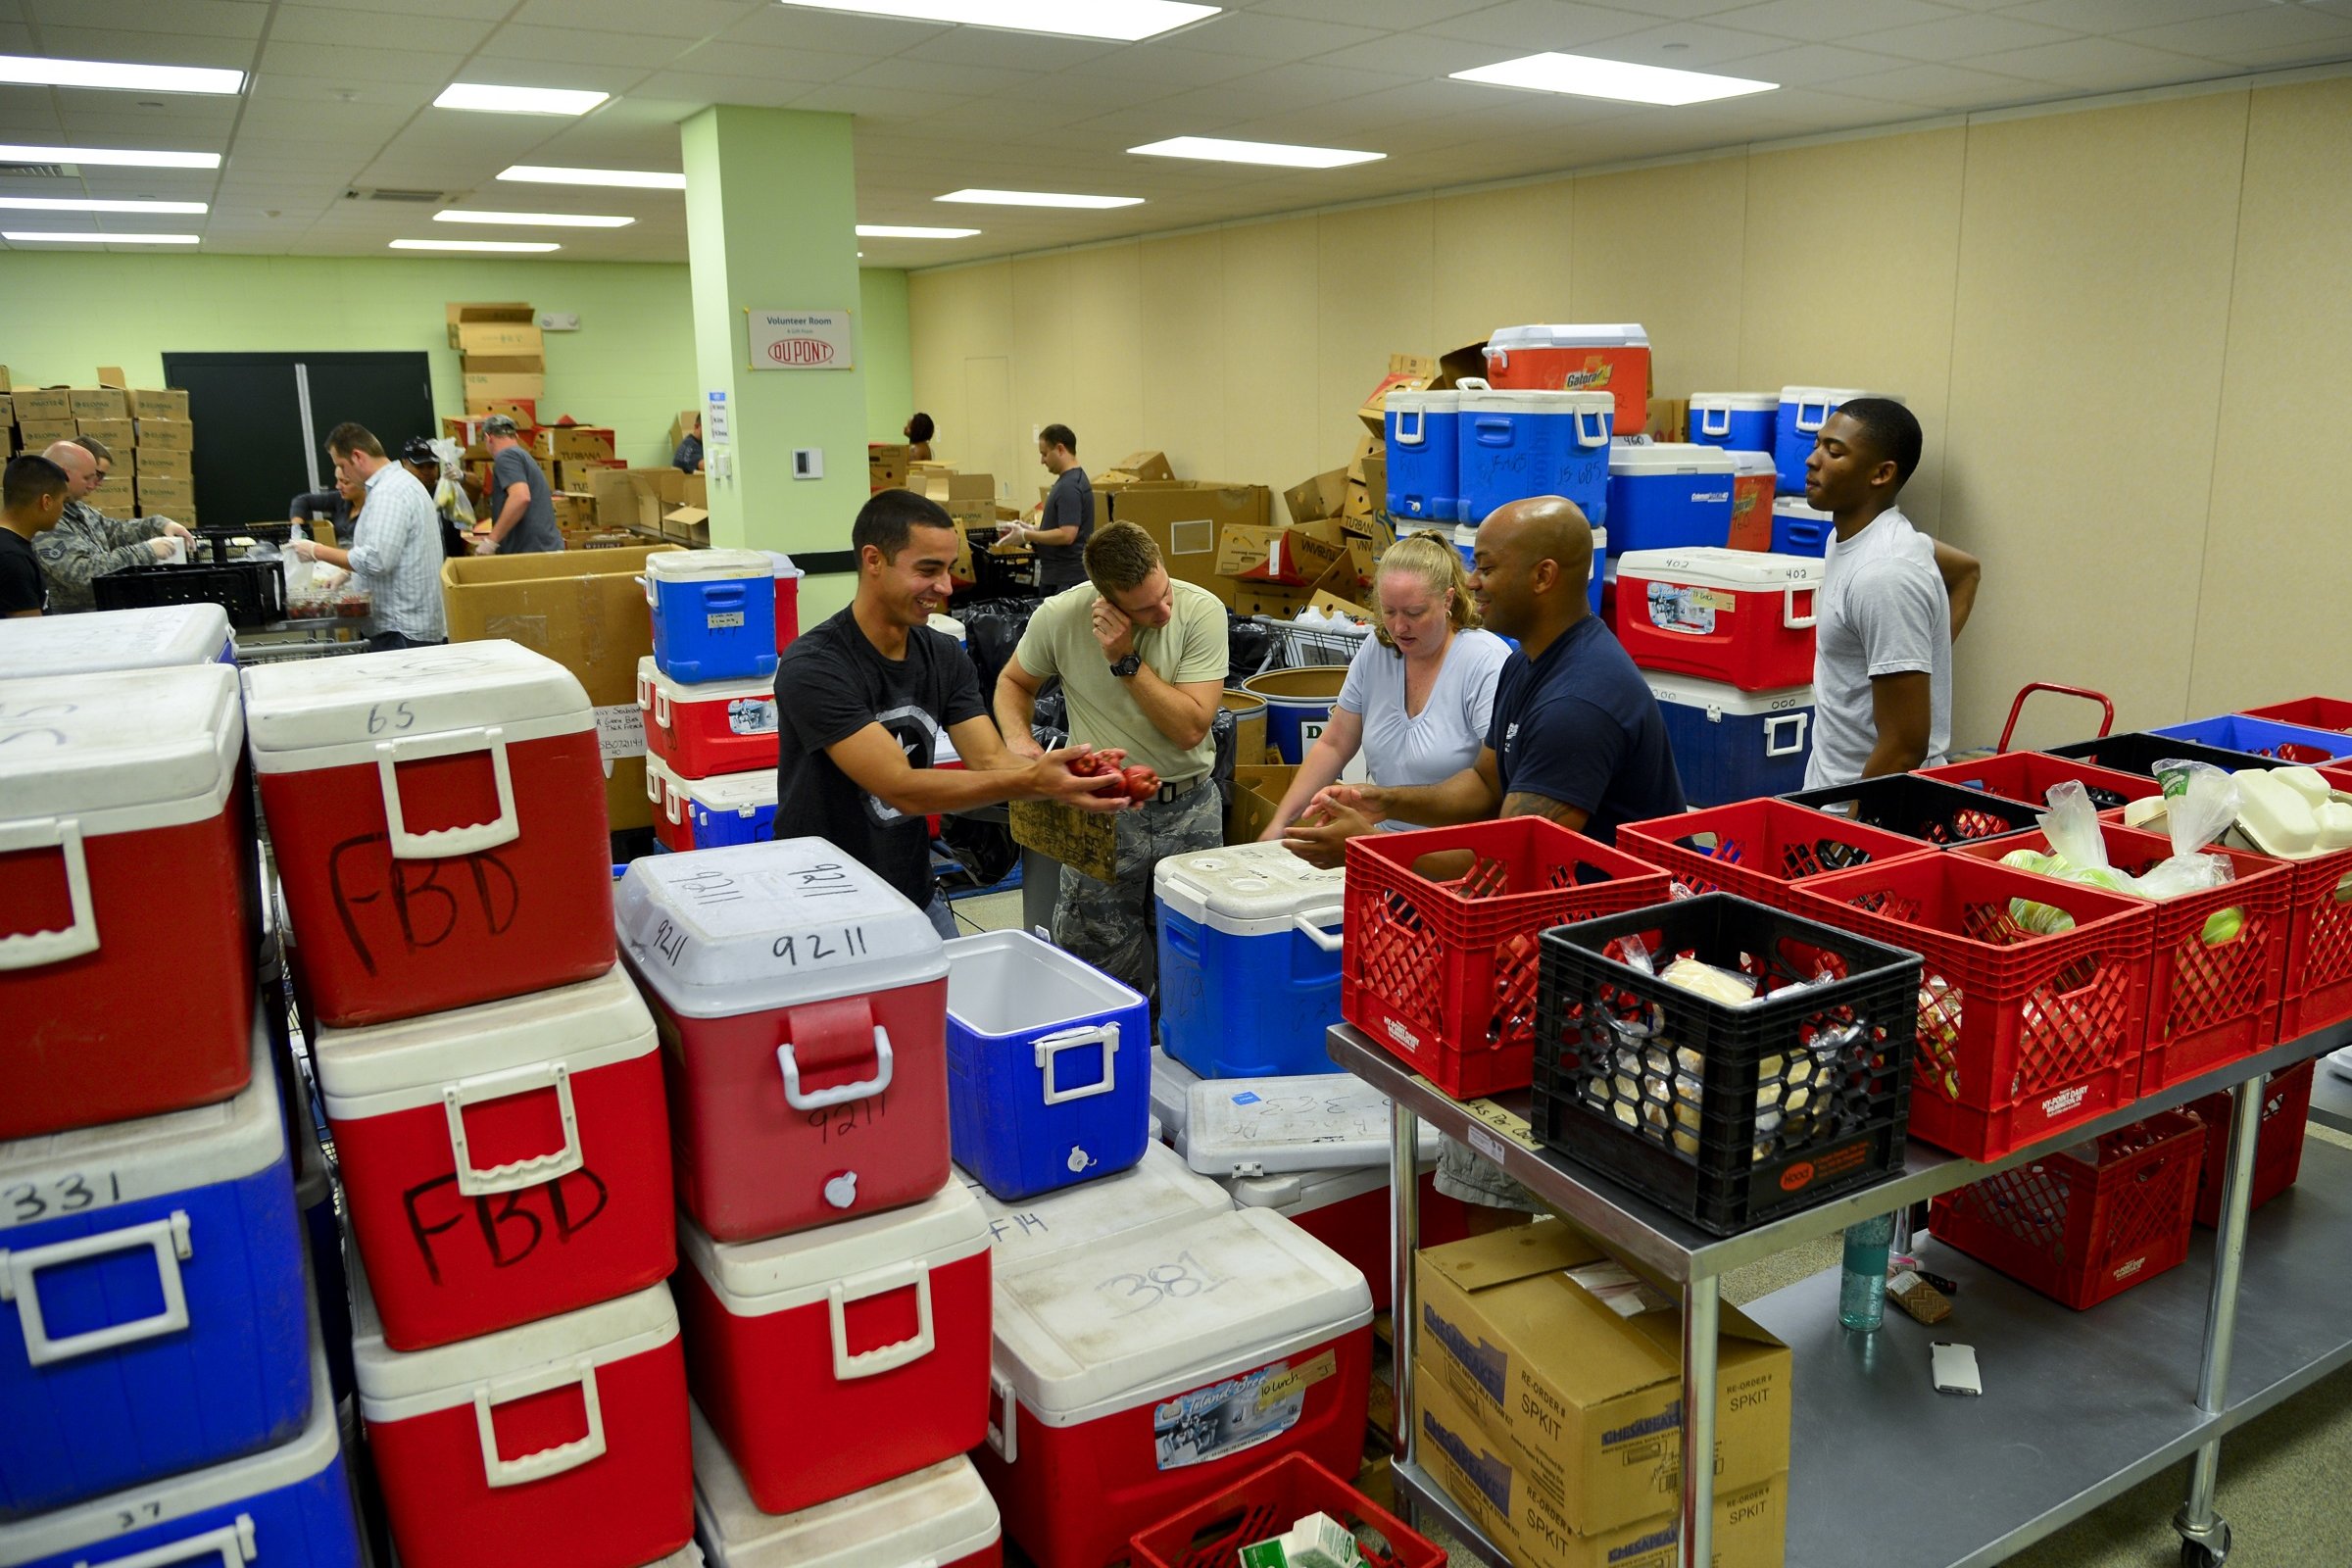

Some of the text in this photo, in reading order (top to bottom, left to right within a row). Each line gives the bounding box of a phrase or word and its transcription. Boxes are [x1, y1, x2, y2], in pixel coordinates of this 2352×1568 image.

[767, 317, 832, 325] Volunteer Room
[1624, 435, 1644, 446] 460
[561, 452, 602, 462] TURBANA
[1345, 514, 1372, 533] TURBAN
[1666, 559, 1689, 569] 402
[1787, 568, 1807, 579] 402
[368, 701, 416, 735] 65
[328, 831, 519, 978] FBD
[653, 918, 689, 967] 9211
[772, 925, 867, 967] 9211
[2070, 1085, 2088, 1099] DAIRY
[808, 1093, 886, 1146] 9211
[1490, 1113, 1511, 1125] Per
[3, 1171, 122, 1222] 331
[403, 1164, 610, 1287] FBD
[1273, 1373, 1299, 1393] Lunch
[1521, 1370, 1566, 1419] RE-ORDER #
[1727, 1375, 1767, 1395] RE-ORDER
[1189, 1383, 1233, 1414] Island
[1730, 1387, 1771, 1412] SPKIT
[1521, 1393, 1562, 1442] SPKIT
[1527, 1485, 1567, 1529] RE-ORDER
[1726, 1490, 1764, 1508] RE-ORDER
[117, 1500, 161, 1528] 37
[1729, 1500, 1767, 1525] SPKIT
[1527, 1508, 1569, 1557] SPKIT
